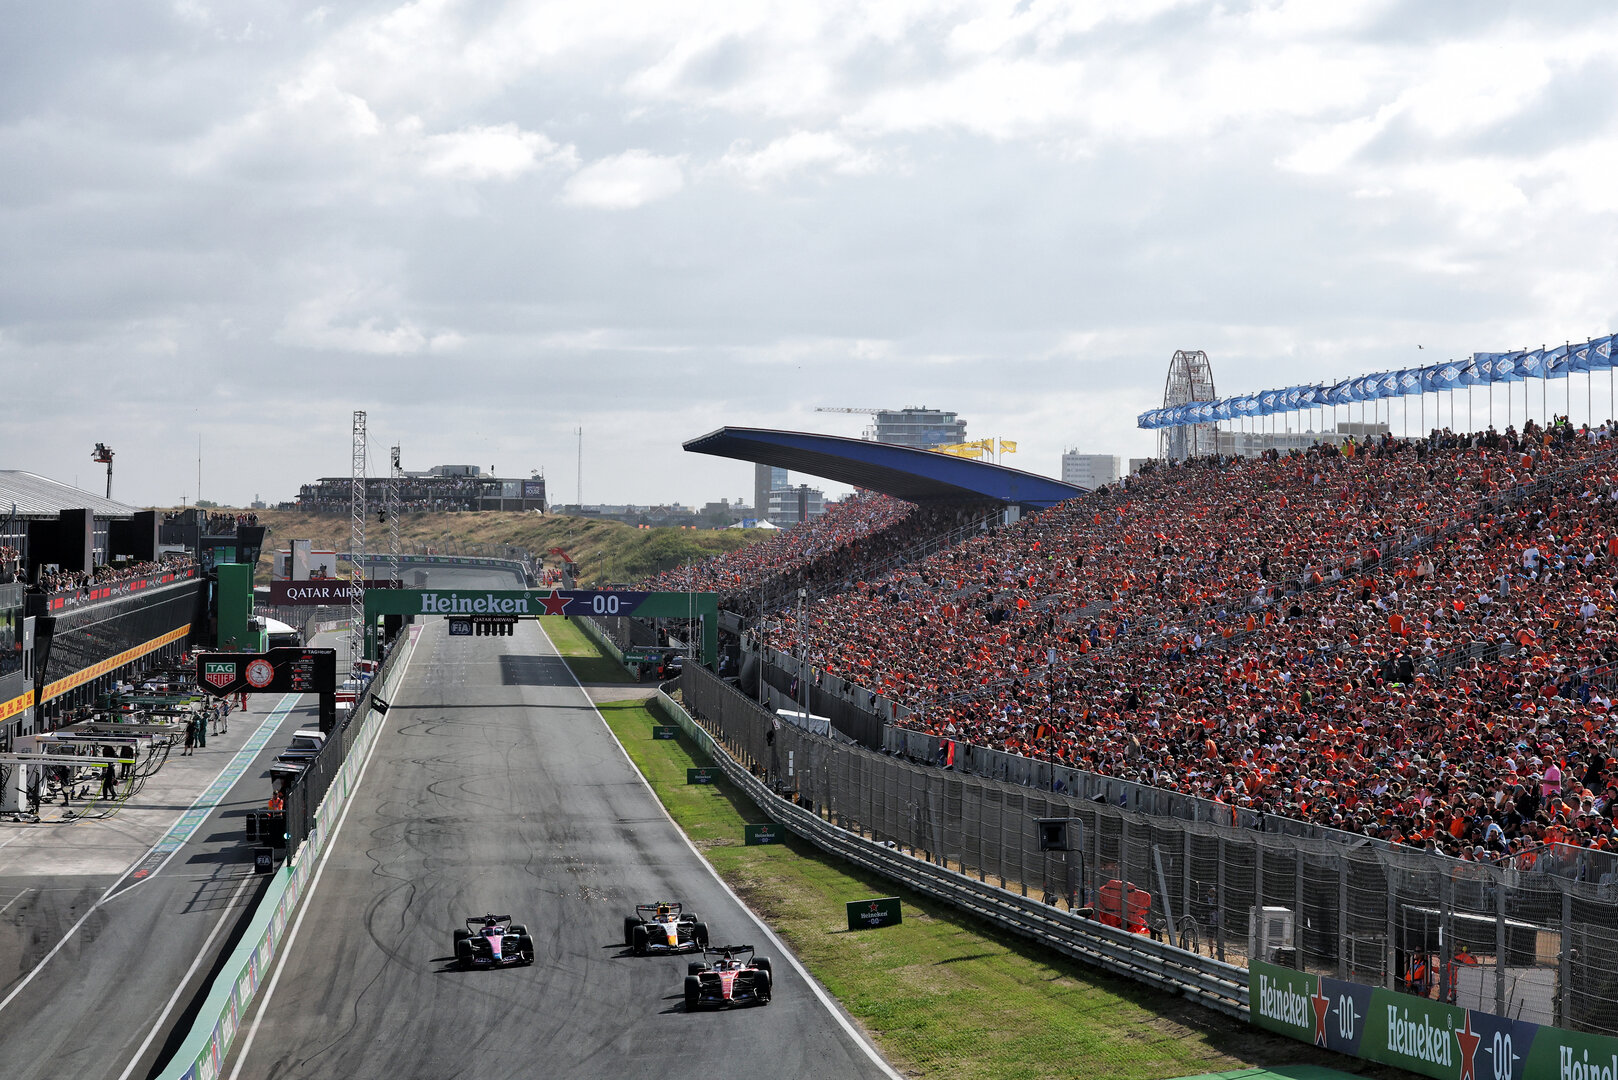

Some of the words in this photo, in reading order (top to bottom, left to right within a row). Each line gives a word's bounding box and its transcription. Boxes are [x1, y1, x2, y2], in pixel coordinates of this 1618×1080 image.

[287, 587, 330, 600] QATAR
[421, 593, 529, 613] Heineken
[593, 595, 619, 614] 0.0
[208, 664, 233, 672] TAG
[207, 674, 234, 686] HEUER
[1259, 974, 1309, 1028] Heineken
[1339, 994, 1354, 1040] 0.0
[1387, 1004, 1452, 1067] Heineken
